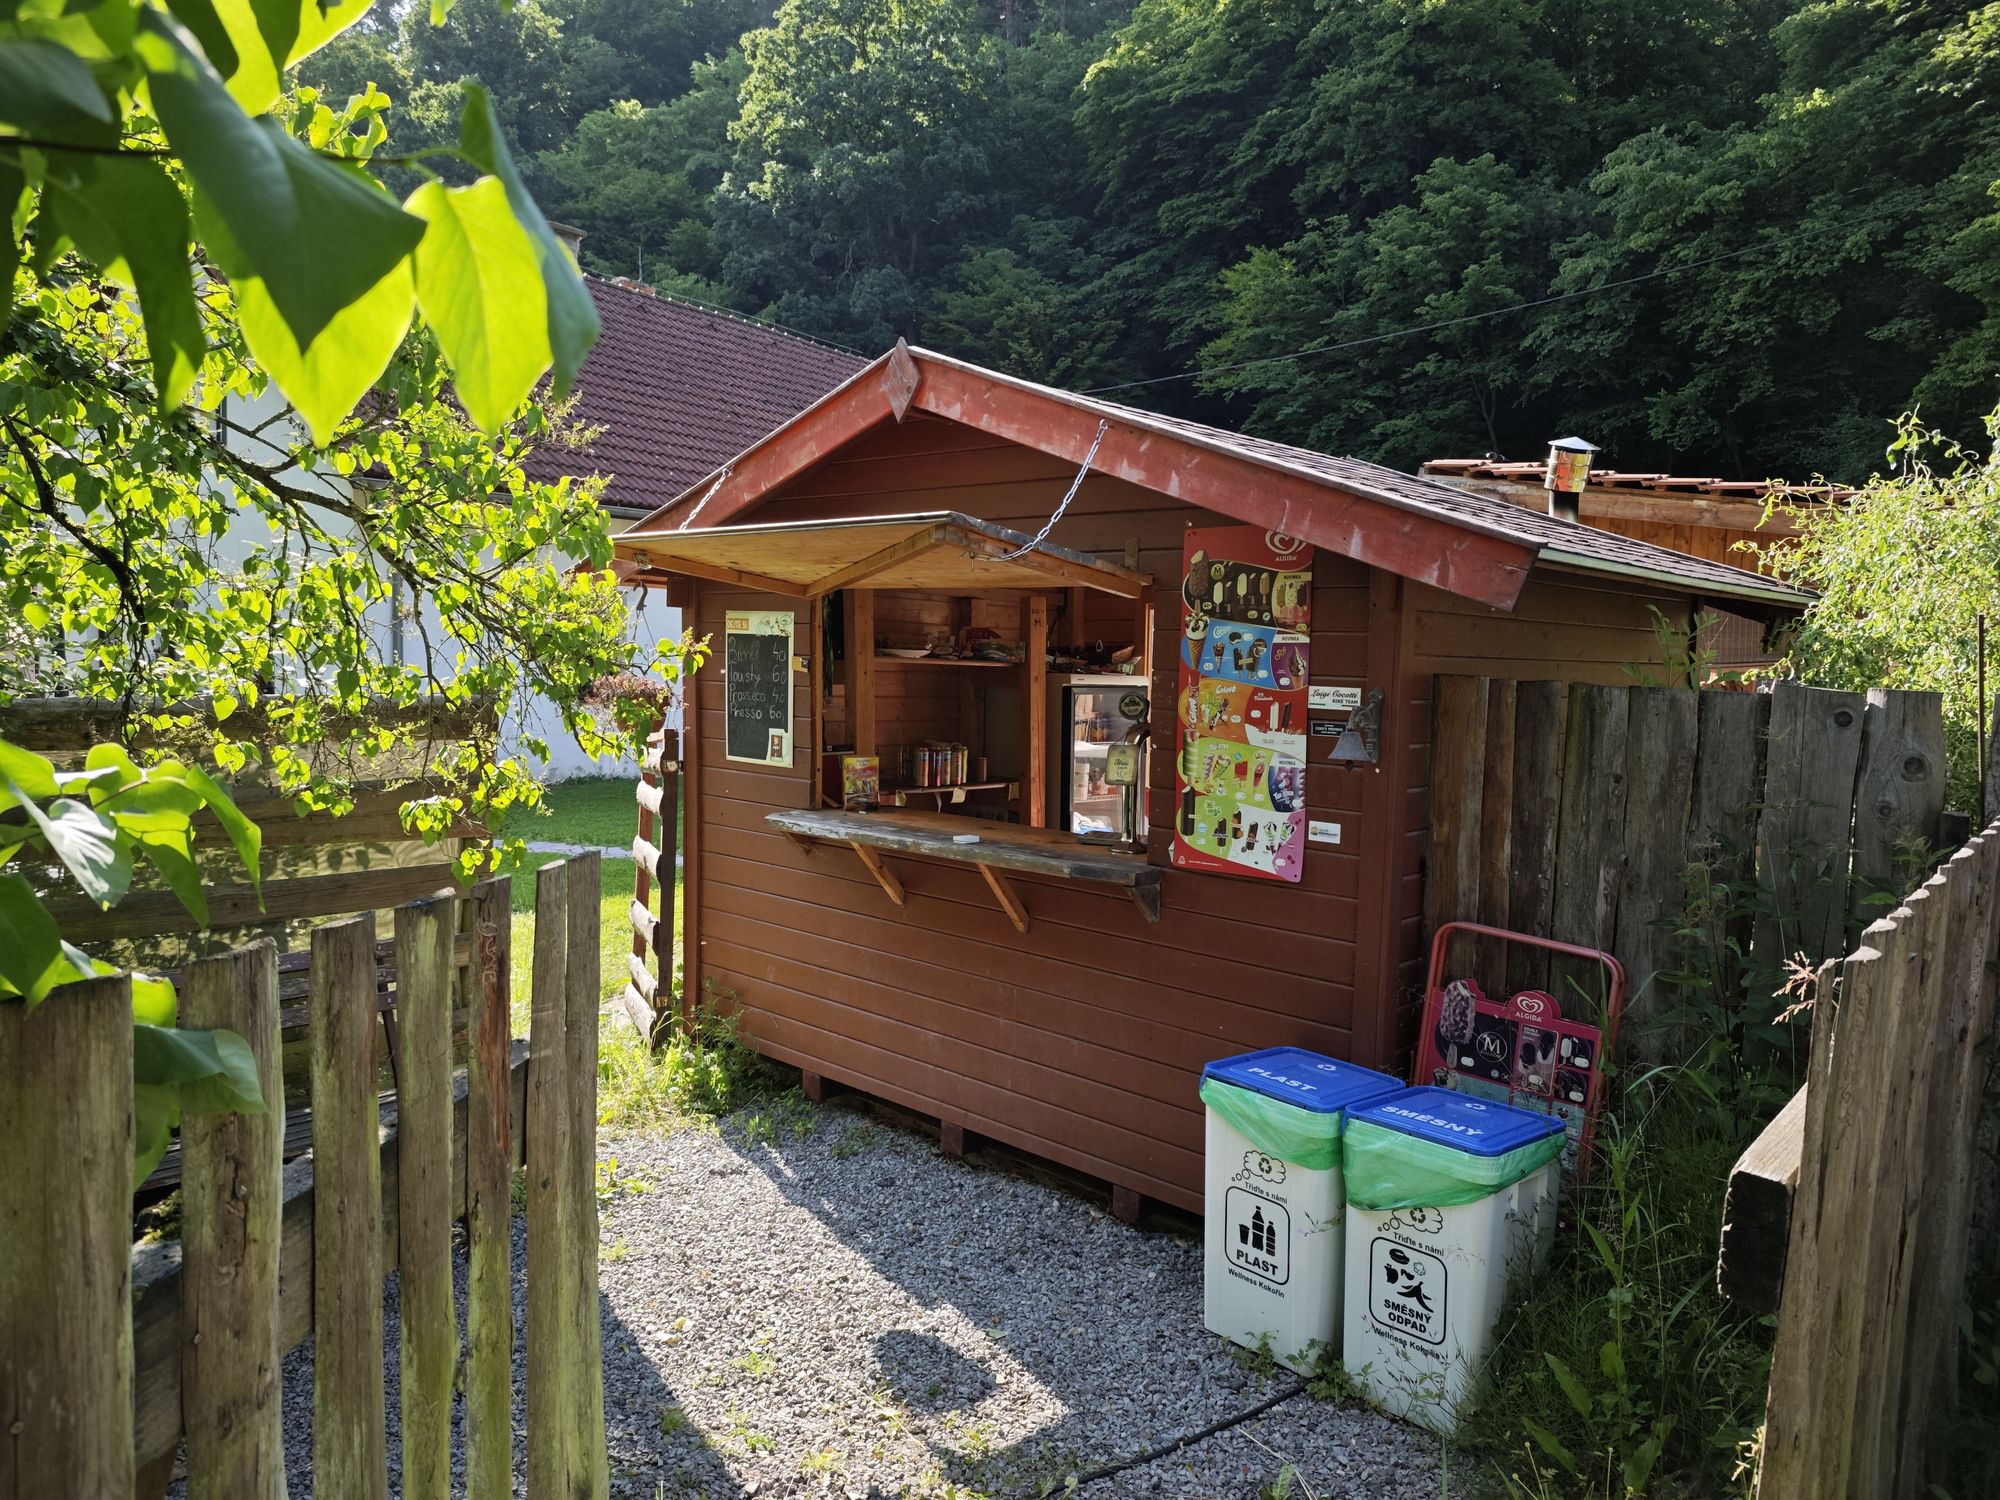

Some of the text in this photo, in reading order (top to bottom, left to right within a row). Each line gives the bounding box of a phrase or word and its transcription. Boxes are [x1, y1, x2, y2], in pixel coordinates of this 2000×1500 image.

[1312, 689, 1330, 699] Luigi
[1515, 1011, 1542, 1022] ALGIDA
[1247, 1067, 1318, 1091] PLAST
[1381, 1106, 1486, 1136] SMĚSNÝ
[1271, 1193, 1288, 1205] námi
[1393, 1232, 1417, 1247] Třiďte
[1424, 1243, 1445, 1257] námi
[1236, 1248, 1278, 1276] PLAST
[1228, 1267, 1257, 1286] Wellness
[1384, 1299, 1432, 1324] SMĚSNÝ
[1388, 1312, 1427, 1333] ODPAD
